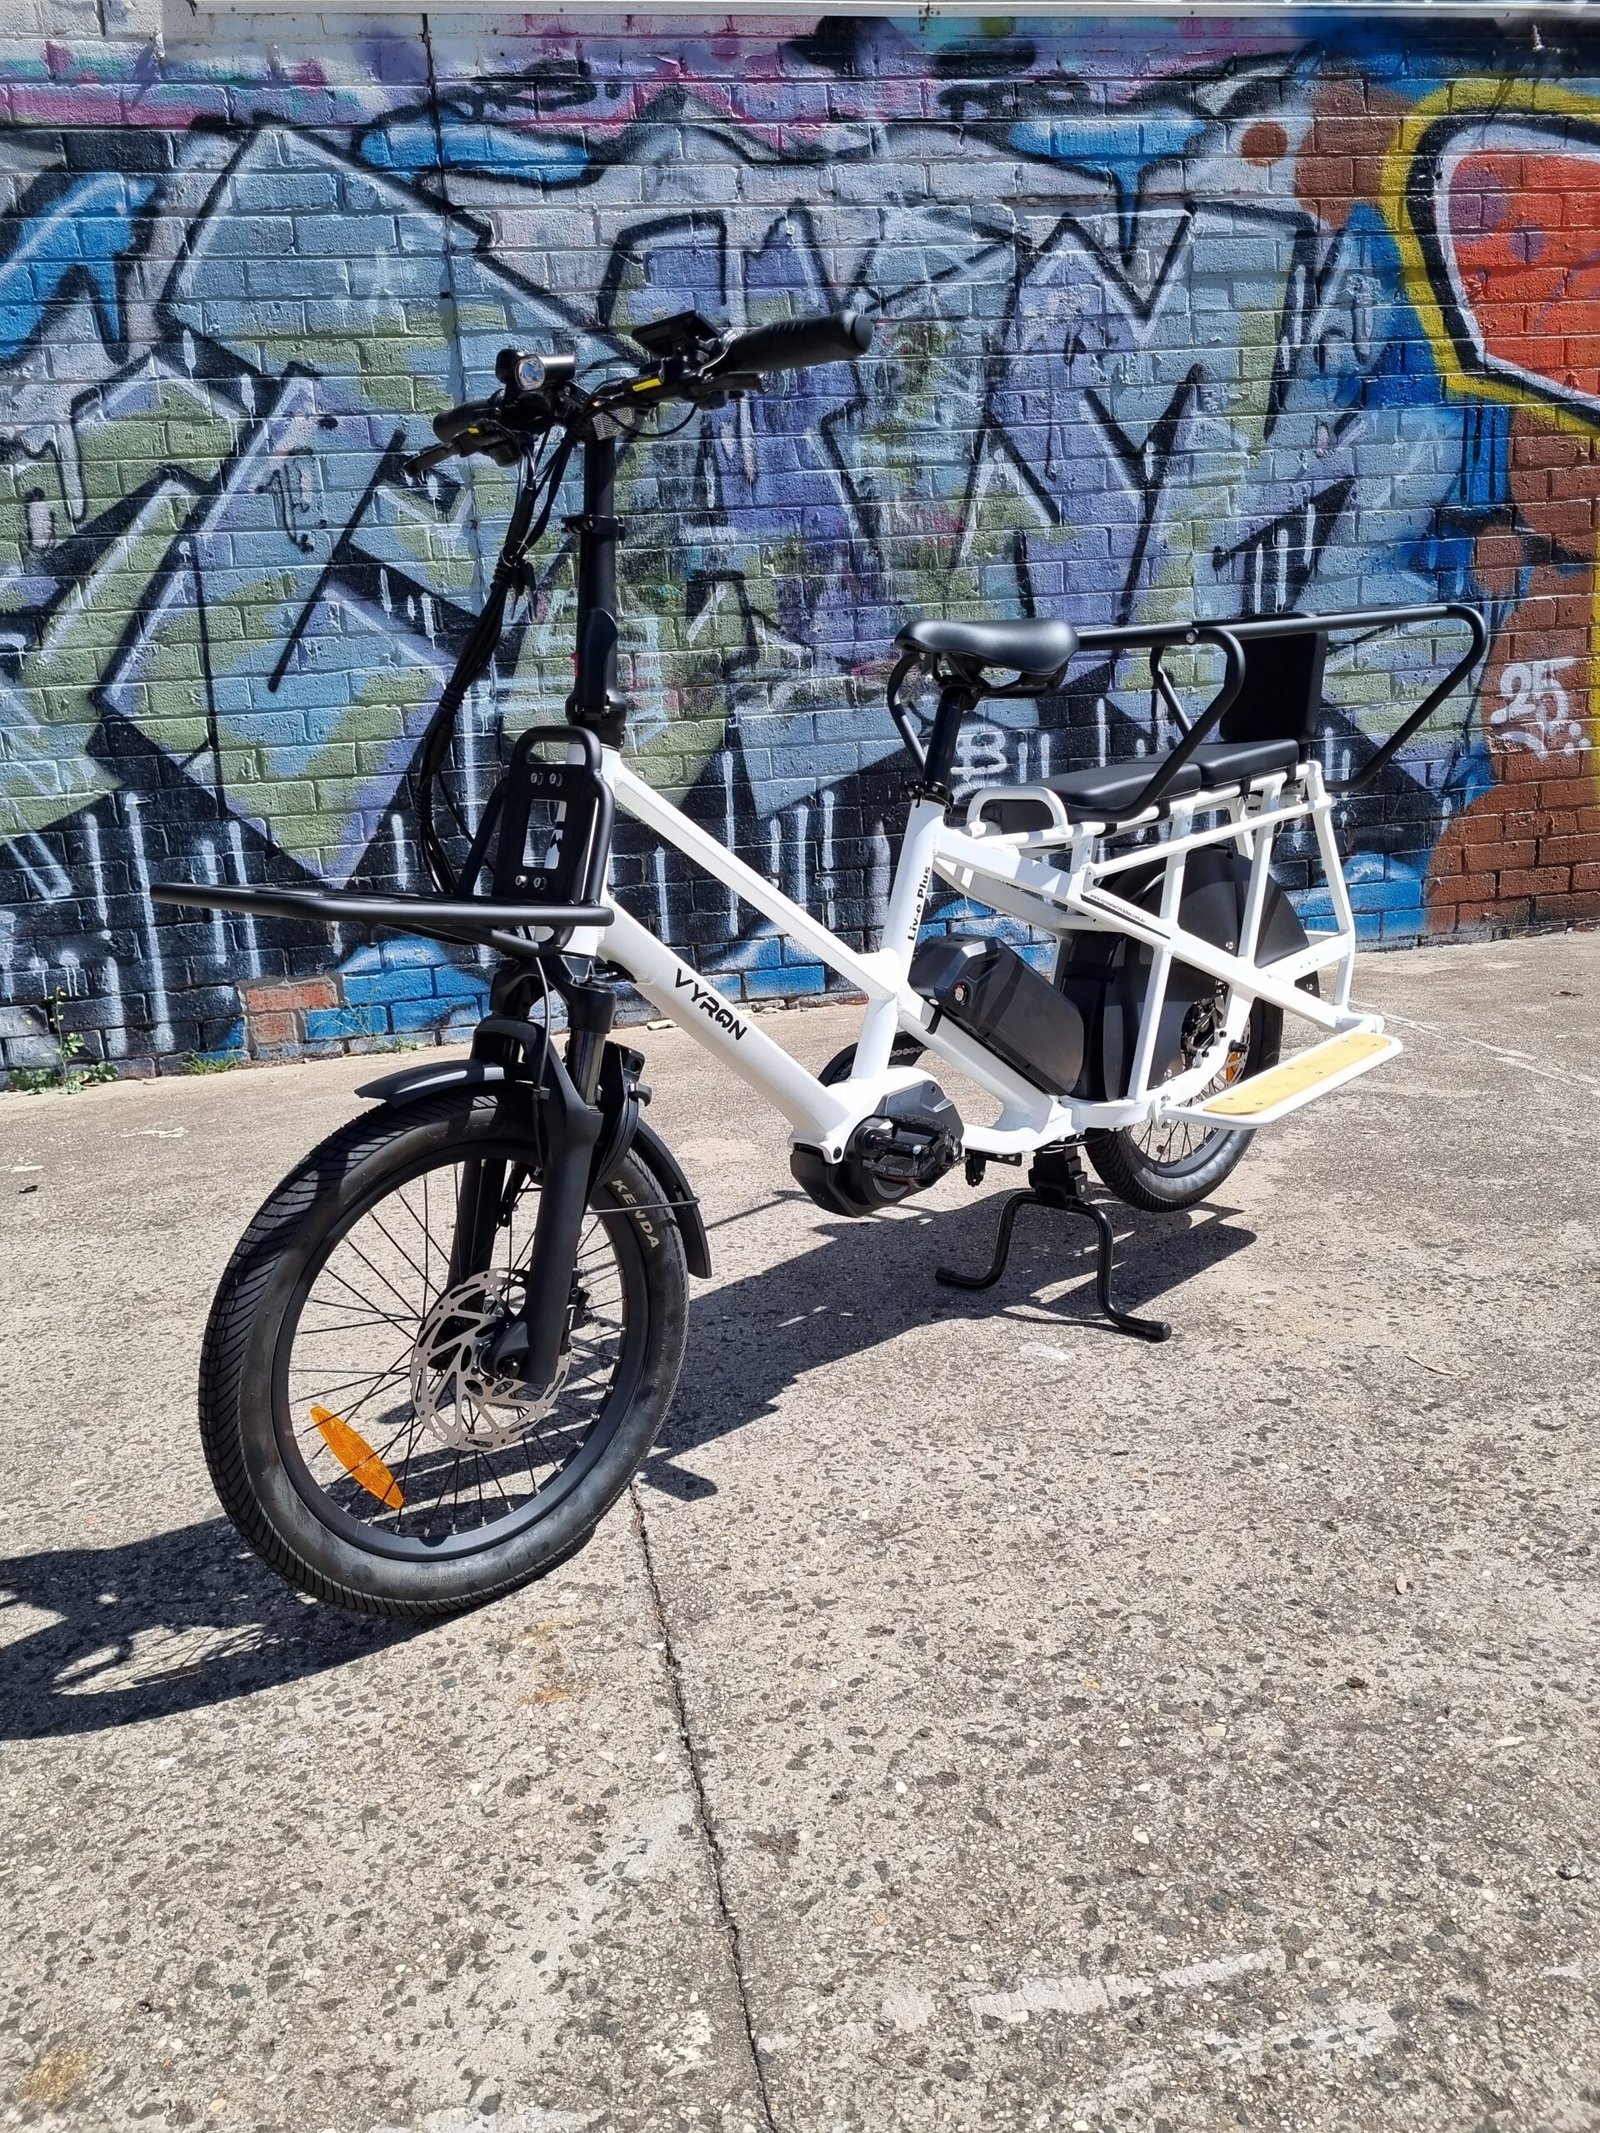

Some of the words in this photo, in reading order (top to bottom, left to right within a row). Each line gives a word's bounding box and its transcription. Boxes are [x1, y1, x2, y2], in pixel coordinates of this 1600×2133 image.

[916, 866, 931, 899] Plus
[675, 967, 748, 1041] VYRON
[610, 1179, 660, 1249] KENDA
